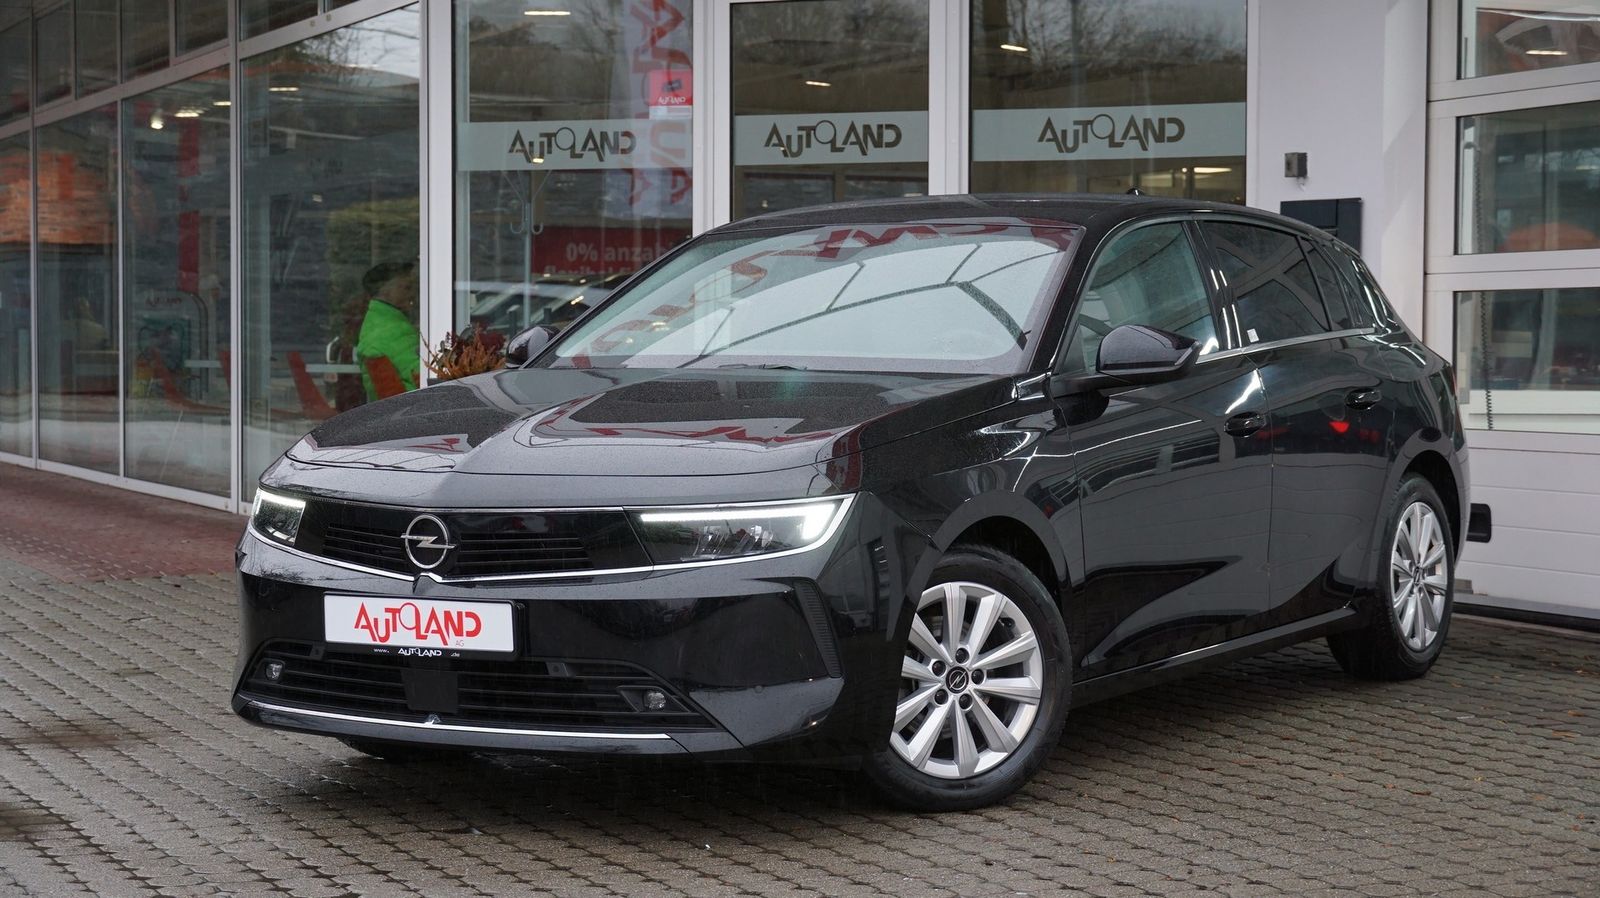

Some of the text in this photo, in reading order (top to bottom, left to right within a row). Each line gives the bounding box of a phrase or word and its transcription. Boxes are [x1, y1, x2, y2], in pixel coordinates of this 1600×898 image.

[508, 127, 636, 164] AUTOLAND
[764, 120, 902, 158] AUTOLAND
[1037, 114, 1186, 154] AUTOLAND
[566, 243, 598, 262] 0%
[354, 602, 482, 646] AUTOLAND
[397, 647, 442, 657] AUTOLAND
